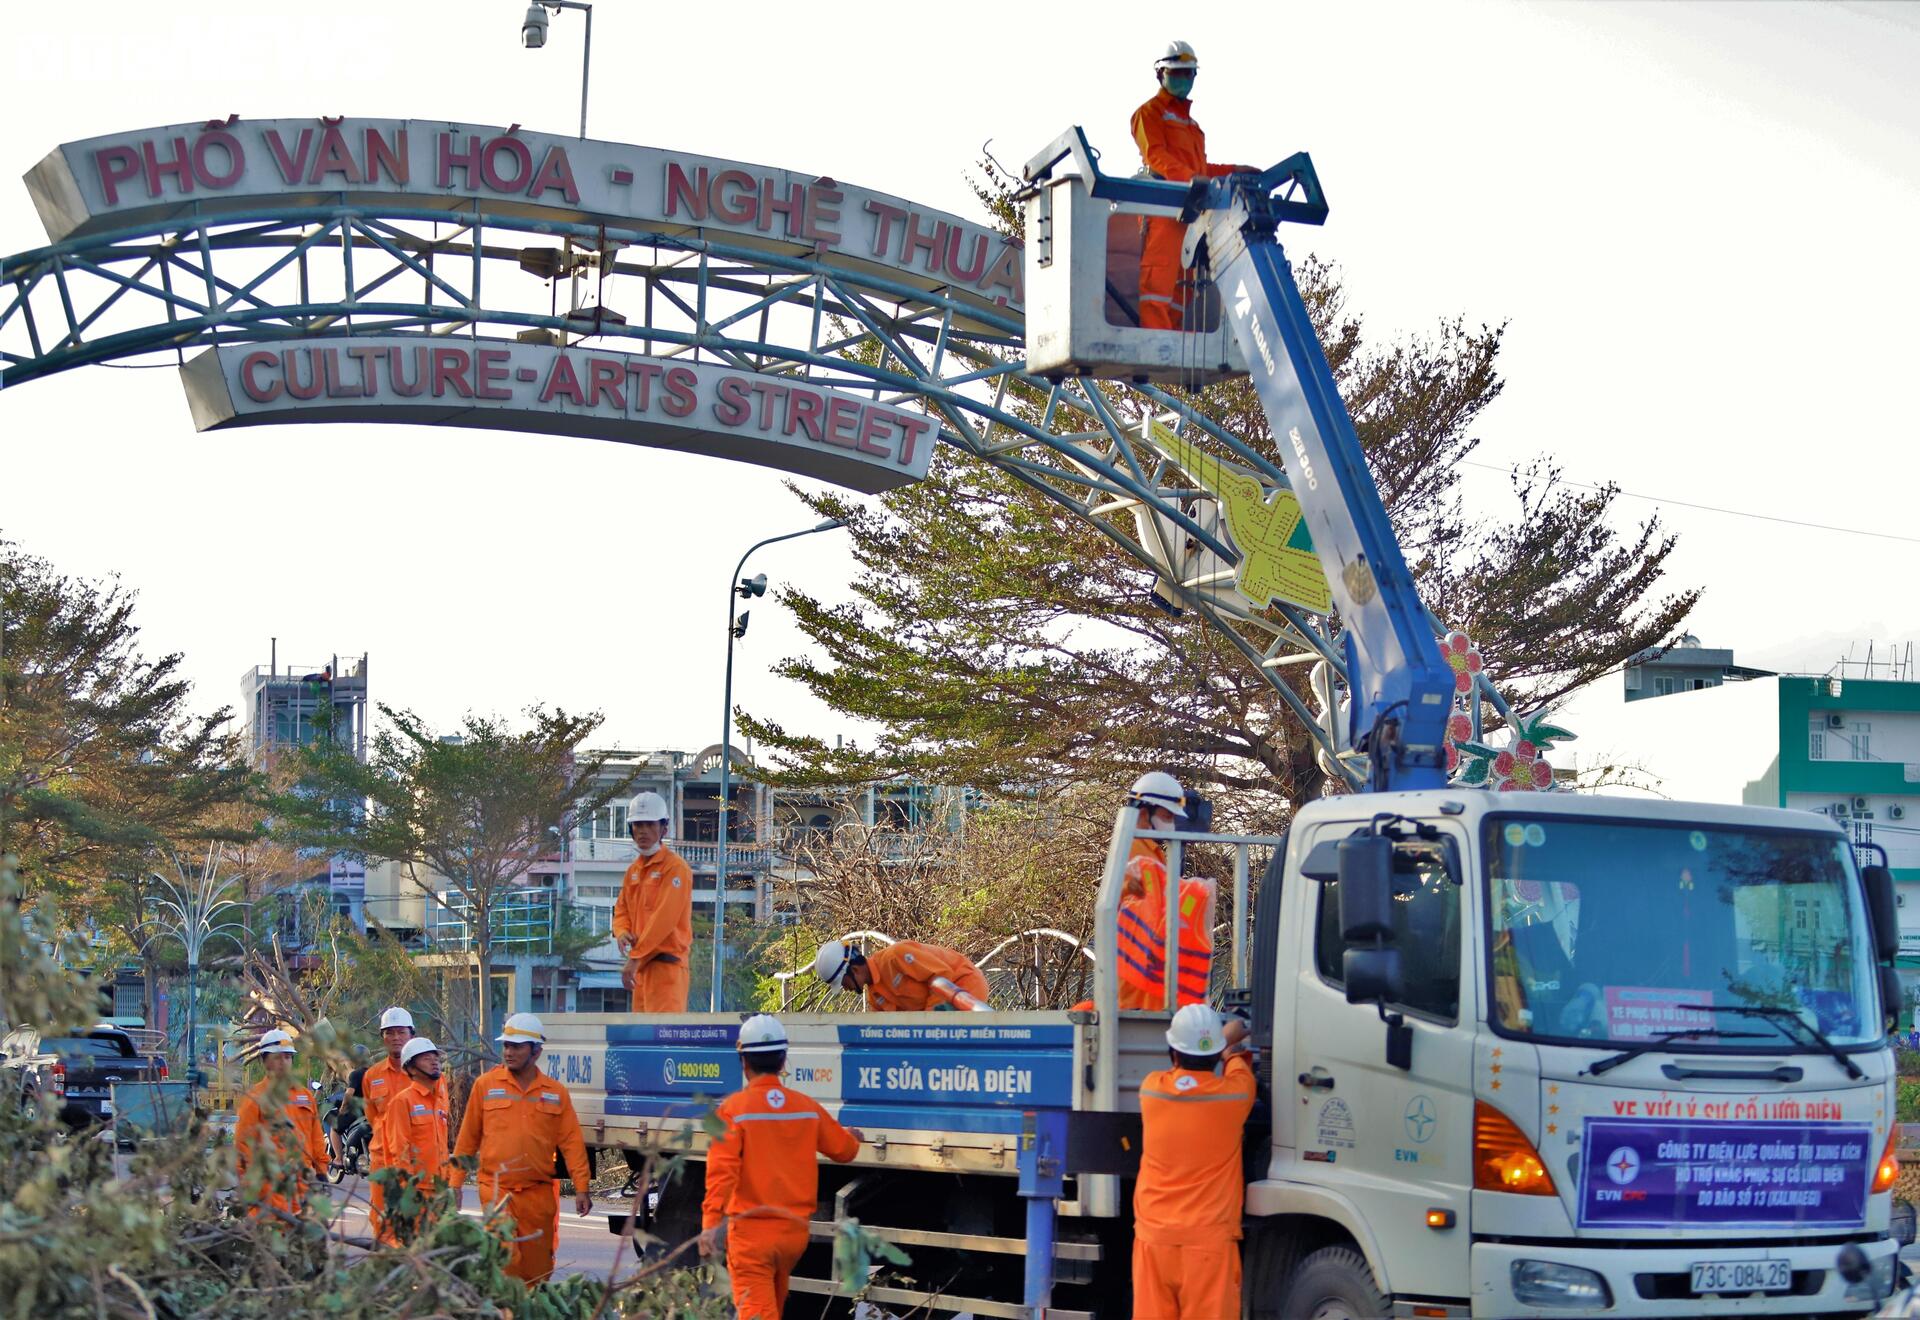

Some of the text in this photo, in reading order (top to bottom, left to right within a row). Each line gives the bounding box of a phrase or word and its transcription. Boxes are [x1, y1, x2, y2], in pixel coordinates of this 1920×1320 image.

[94, 114, 246, 205] PHỐ
[264, 115, 410, 185] VĂN
[436, 124, 581, 203] HÓA
[663, 161, 844, 254] NGHỆ
[1251, 313, 1275, 376] TADANO
[713, 376, 931, 465] STREET
[885, 1028, 910, 1039] CÔNG
[913, 1029, 923, 1039] TY
[950, 1029, 968, 1041] LỰC
[999, 1029, 1031, 1039] TRUNG
[677, 1062, 720, 1078] 19001909
[859, 1061, 1032, 1098] XE SỬA CHỮA ĐIỆN
[1657, 1140, 1691, 1159] CÔNG
[1692, 1143, 1707, 1159] TY
[1735, 1142, 1758, 1163] LỰC
[1759, 1140, 1797, 1161] QUẢNG
[1797, 1144, 1815, 1163] TRỊ
[1771, 1167, 1787, 1187] SỰ
[1697, 1190, 1714, 1206] DO
[1714, 1187, 1736, 1206] BÃO
[1737, 1185, 1753, 1206] SỐ
[1754, 1190, 1767, 1206] 13
